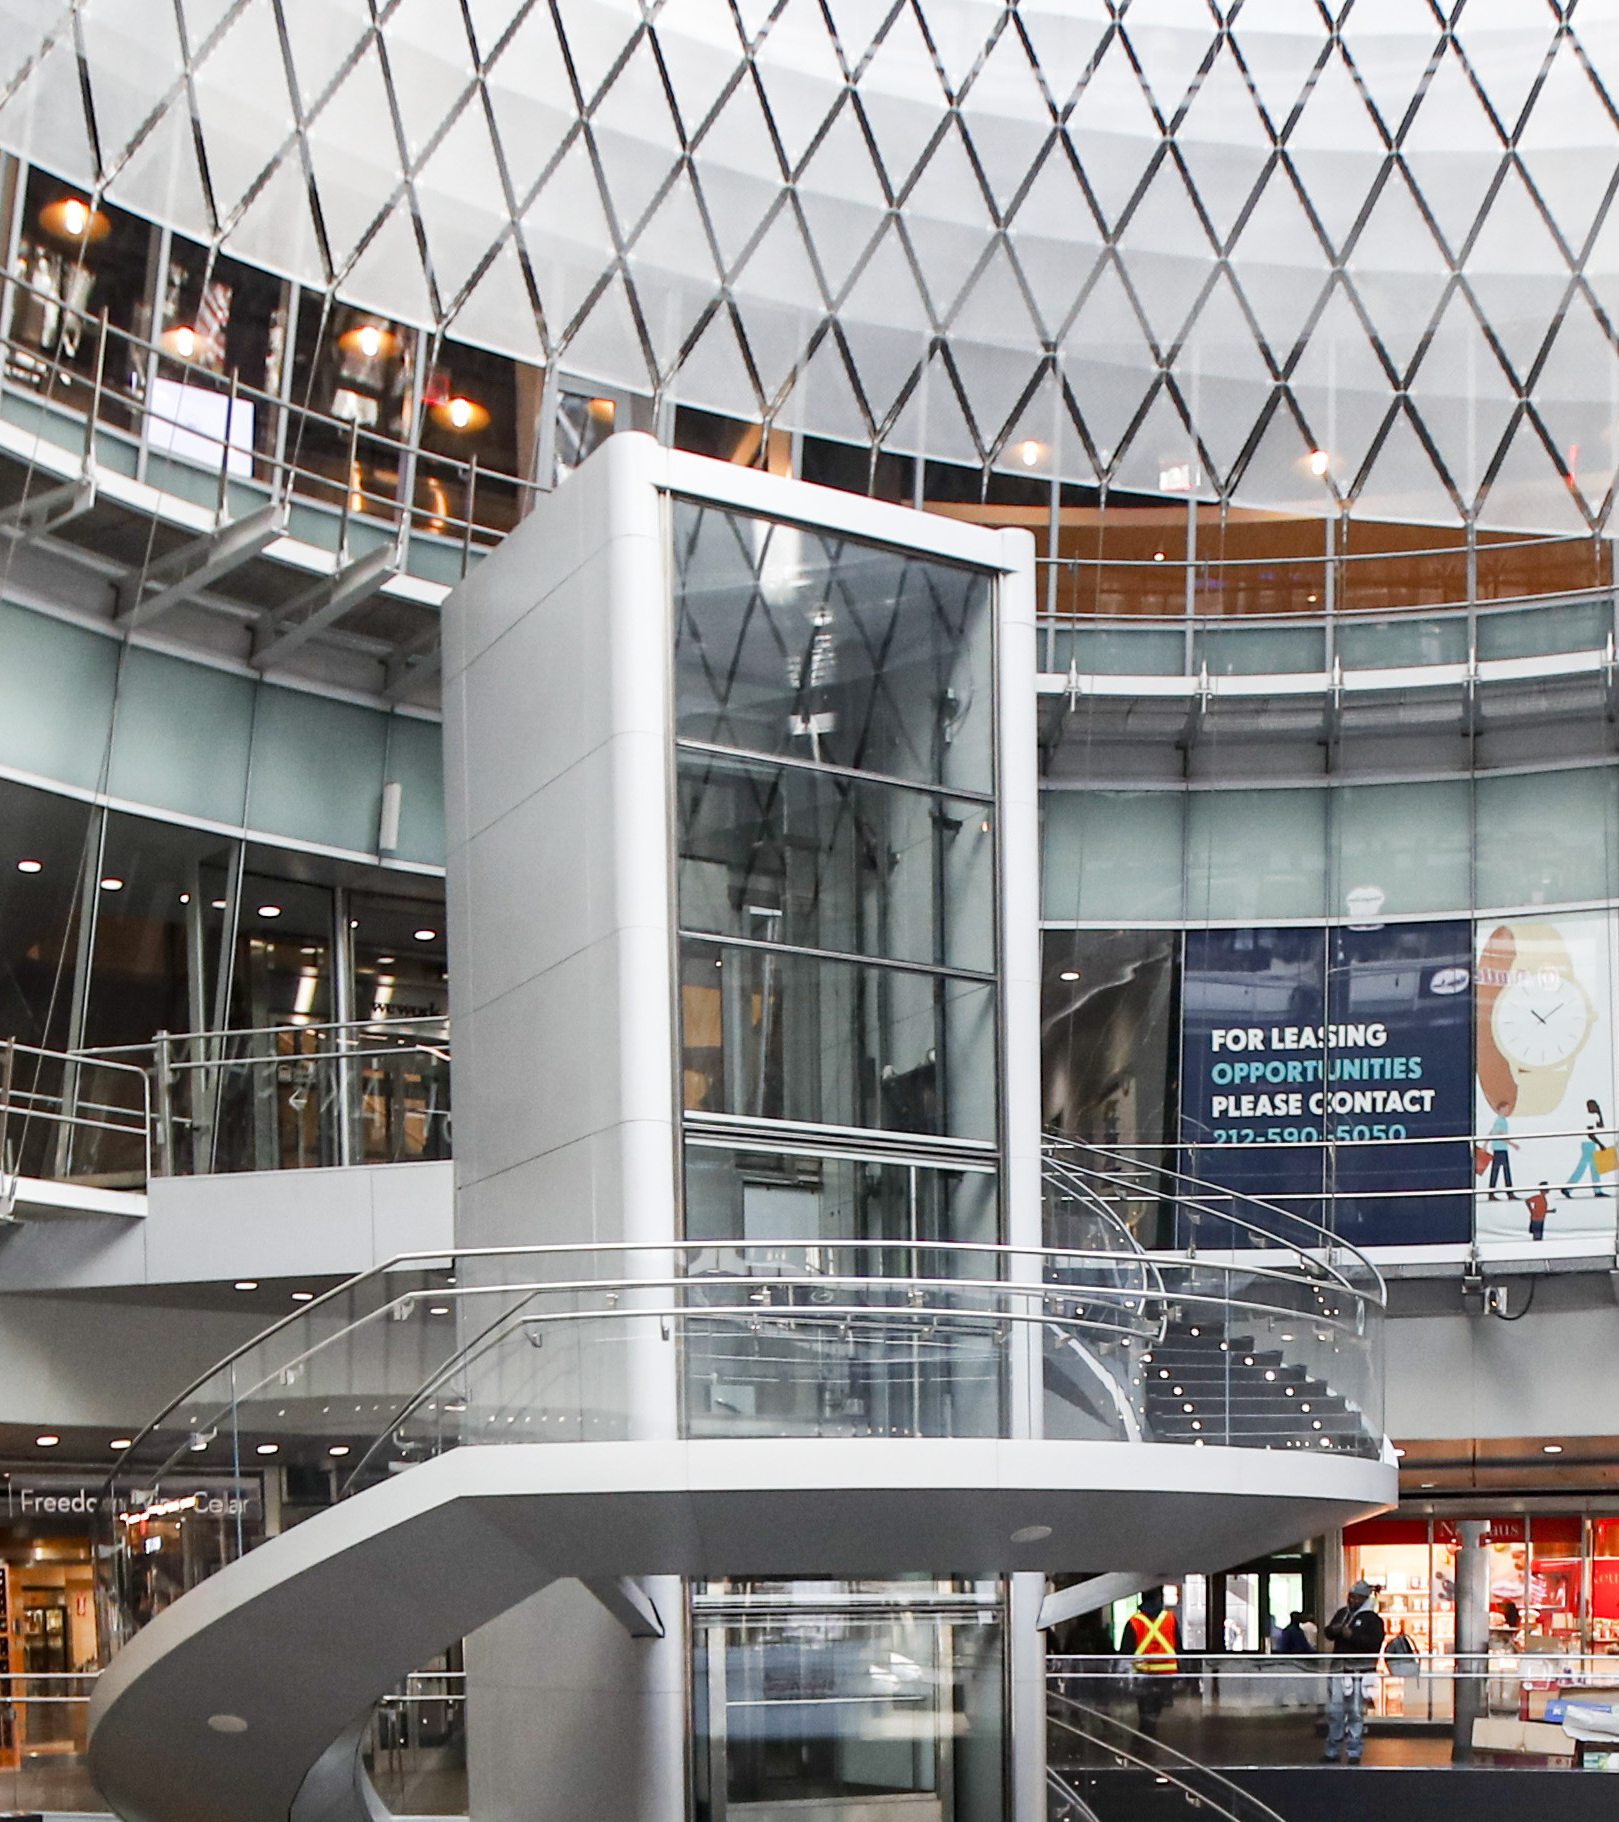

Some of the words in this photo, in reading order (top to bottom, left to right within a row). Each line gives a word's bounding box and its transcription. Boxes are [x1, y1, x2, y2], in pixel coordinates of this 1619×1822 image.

[1211, 1028, 1265, 1052] FOR
[1271, 1023, 1388, 1050] LEASING
[1211, 1056, 1423, 1086] OPPORTUNITIES
[1211, 1094, 1303, 1118] PLEASE
[1308, 1089, 1436, 1116] CONTACT
